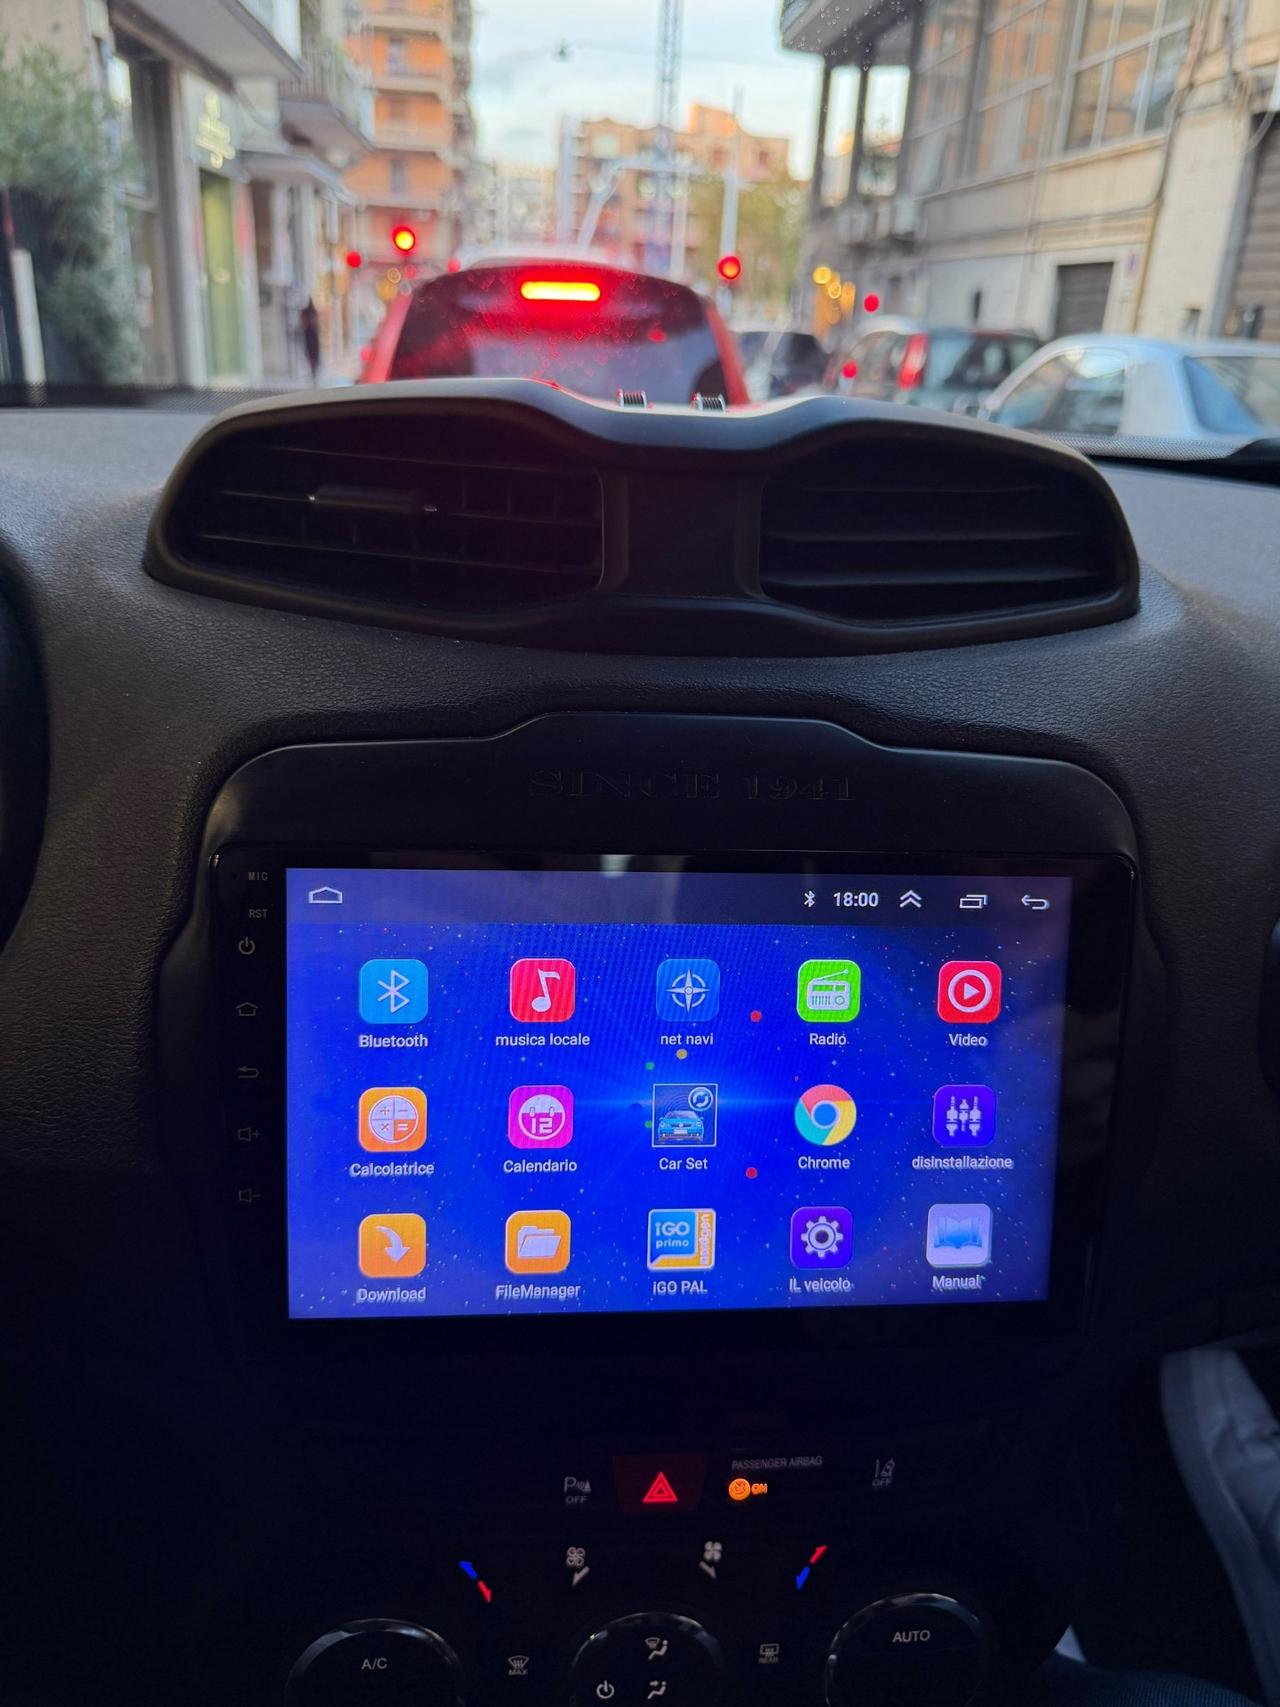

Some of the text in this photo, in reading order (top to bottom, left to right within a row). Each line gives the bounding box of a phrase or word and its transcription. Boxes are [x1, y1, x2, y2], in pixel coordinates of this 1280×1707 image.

[529, 766, 855, 801] SINCE 1941
[248, 871, 268, 881] MIC
[833, 891, 879, 909] 18:00
[249, 908, 268, 919] RST
[359, 1033, 428, 1049] Bluetooth
[495, 1033, 591, 1047] musica locale
[660, 1033, 714, 1046] net navi
[809, 1032, 847, 1047] Radio
[948, 1032, 988, 1048] Video
[350, 1161, 435, 1178] Calcolatrice
[503, 1159, 578, 1173] Calendario
[659, 1157, 708, 1170] Car Set
[798, 1156, 851, 1171] Chrome
[911, 1155, 1014, 1170] disinstallazione
[655, 1221, 690, 1236] iGO
[656, 1239, 689, 1249] primo
[653, 1280, 708, 1295] iGO PAL
[804, 1277, 851, 1293] veicolo
[932, 1275, 981, 1290] Manual
[356, 1287, 427, 1304] Download
[495, 1284, 581, 1301] FileManager
[731, 1455, 823, 1470] PASSENGER AIRBAG
[751, 1483, 768, 1495] ON
[872, 1478, 893, 1488] OFF
[565, 1495, 588, 1505] OFF
[892, 1630, 931, 1643] AUTO
[361, 1657, 388, 1670] A/C
